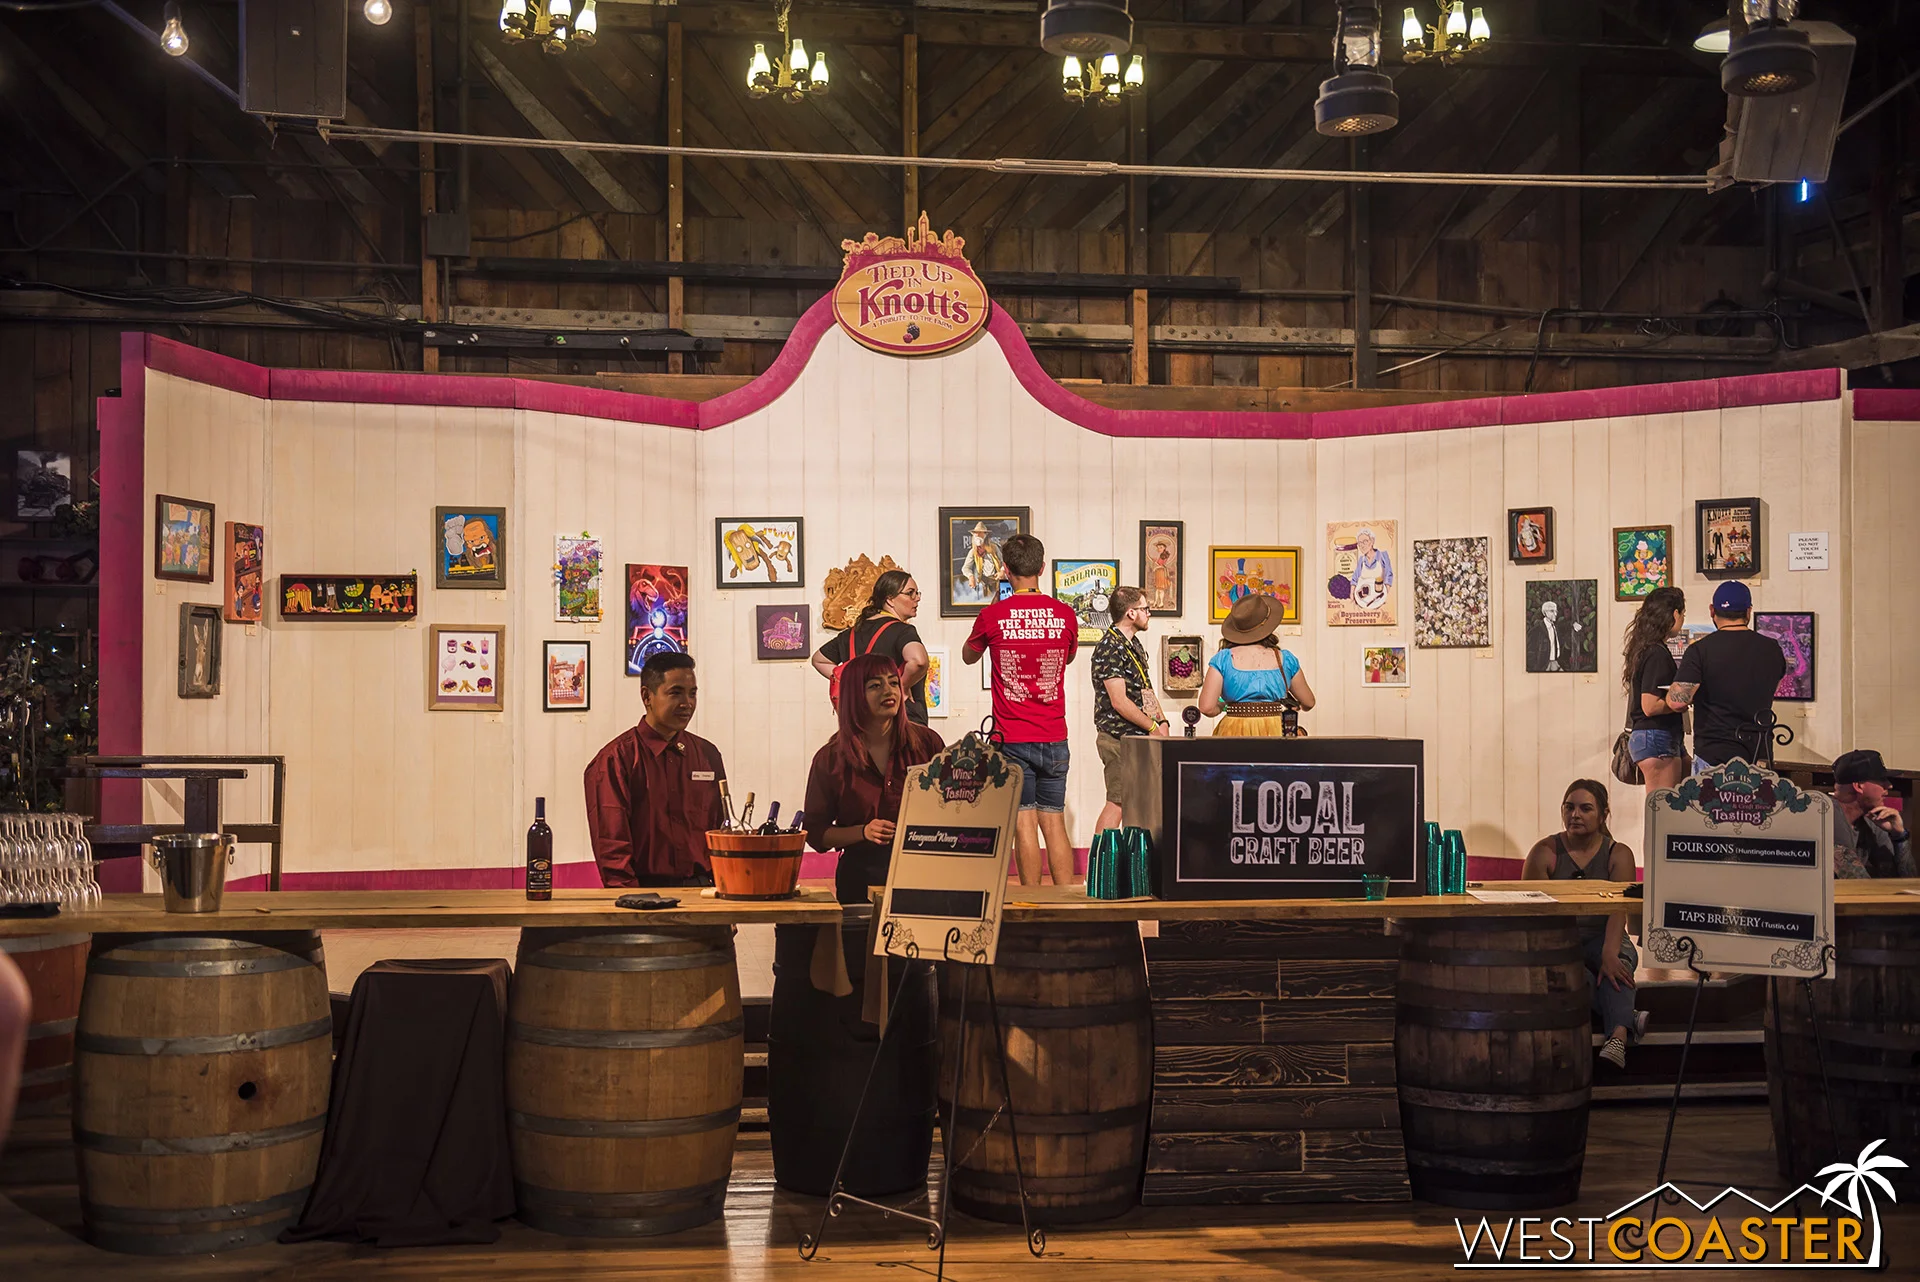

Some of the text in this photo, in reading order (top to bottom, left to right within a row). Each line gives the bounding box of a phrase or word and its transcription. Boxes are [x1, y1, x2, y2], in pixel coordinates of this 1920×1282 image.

[866, 262, 953, 285] TIED UP
[907, 277, 923, 288] IN
[858, 279, 970, 328] Knott's
[1063, 567, 1109, 587] RAILROAD
[1010, 608, 1054, 619] BEFORE
[1340, 611, 1381, 619] Boysenberry
[1345, 617, 1377, 625] Preserves
[997, 618, 1066, 630] THE PARADE
[1002, 629, 1063, 640] PASSES BY
[952, 768, 973, 781] Wine
[945, 786, 976, 802] Tasting
[1719, 791, 1752, 804] Wine
[1230, 780, 1365, 835] LOCAL
[1712, 808, 1761, 824] Tasting
[1230, 837, 1365, 866] CRAFT BEER
[1672, 841, 1703, 853] FOUR
[1705, 843, 1734, 854] SONS
[1735, 847, 1776, 857] (Huntington
[1797, 850, 1810, 858] CA)
[1679, 910, 1705, 923] TAPS
[1707, 913, 1761, 928] BREWERY
[1786, 923, 1799, 931] CA)
